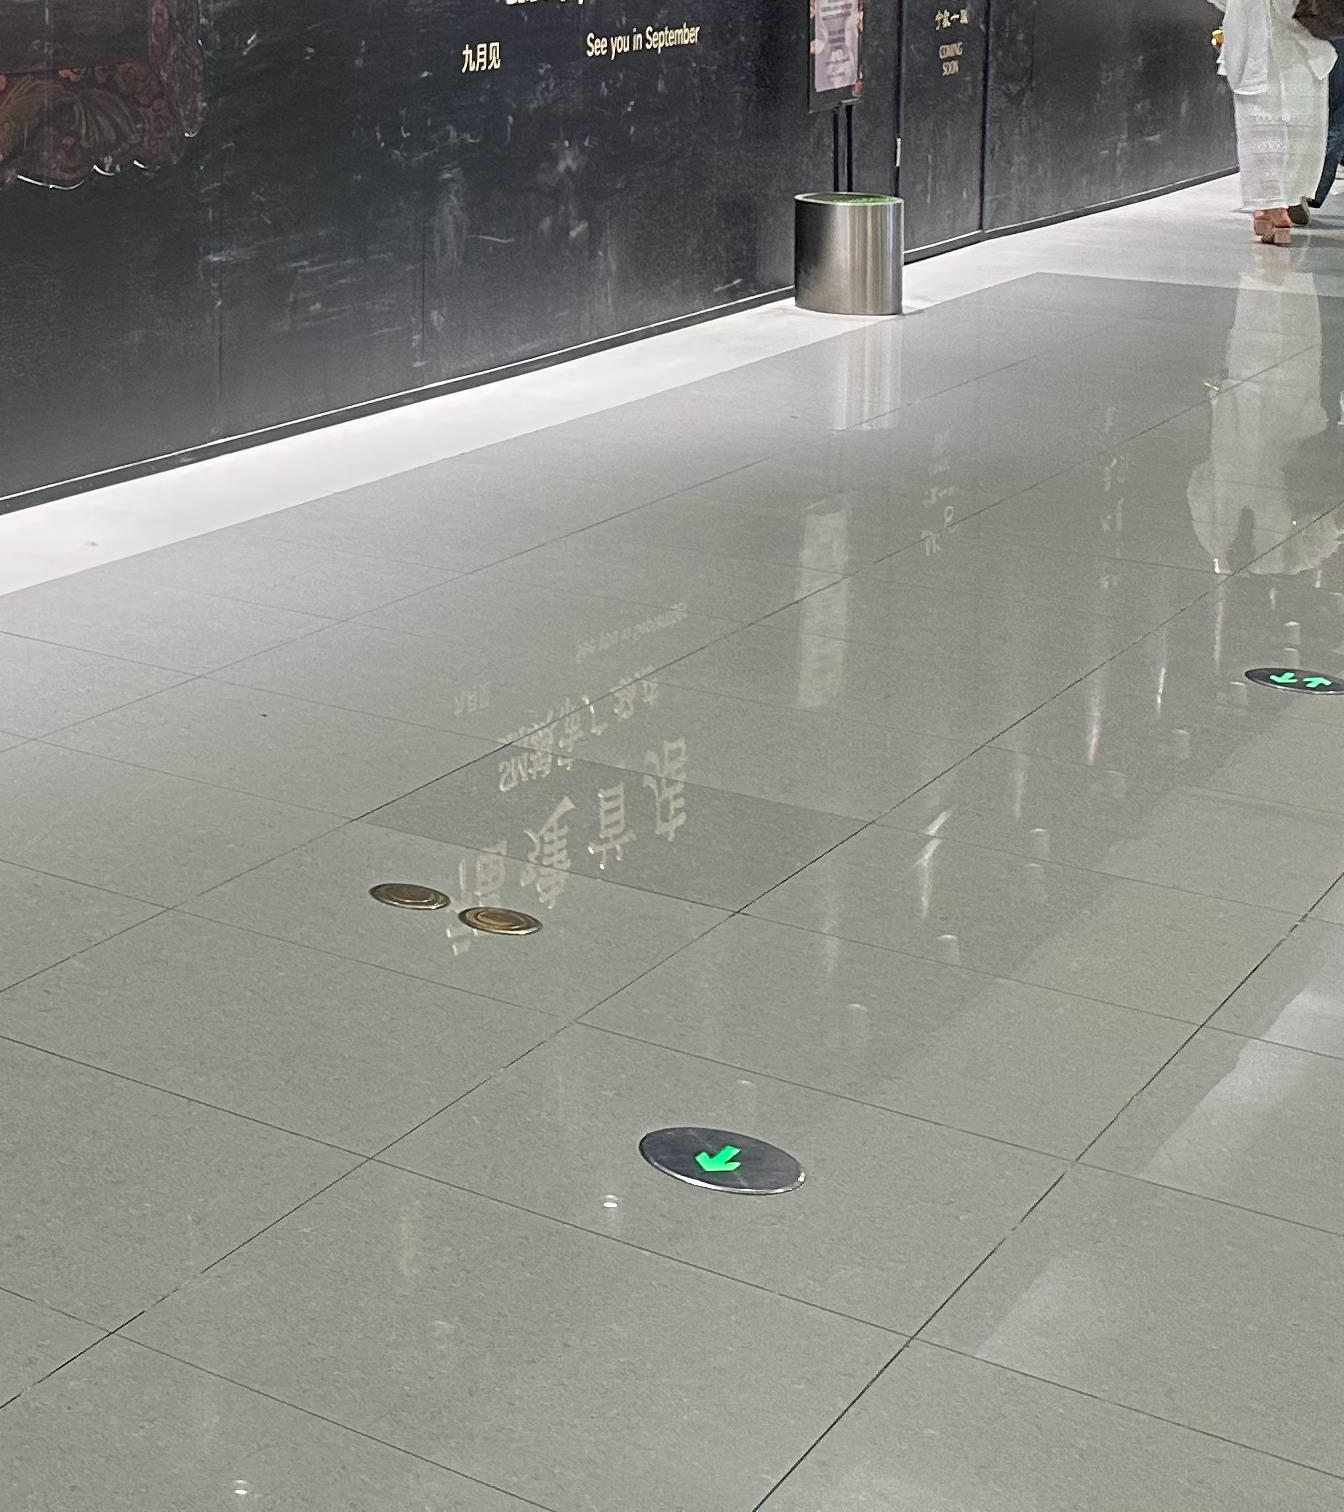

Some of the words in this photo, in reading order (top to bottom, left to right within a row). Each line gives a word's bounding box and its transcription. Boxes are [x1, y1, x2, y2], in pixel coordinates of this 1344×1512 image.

[462, 41, 501, 73] 九月见
[586, 32, 608, 57] See
[610, 35, 630, 61] you
[633, 27, 643, 51] in
[645, 22, 701, 54] September
